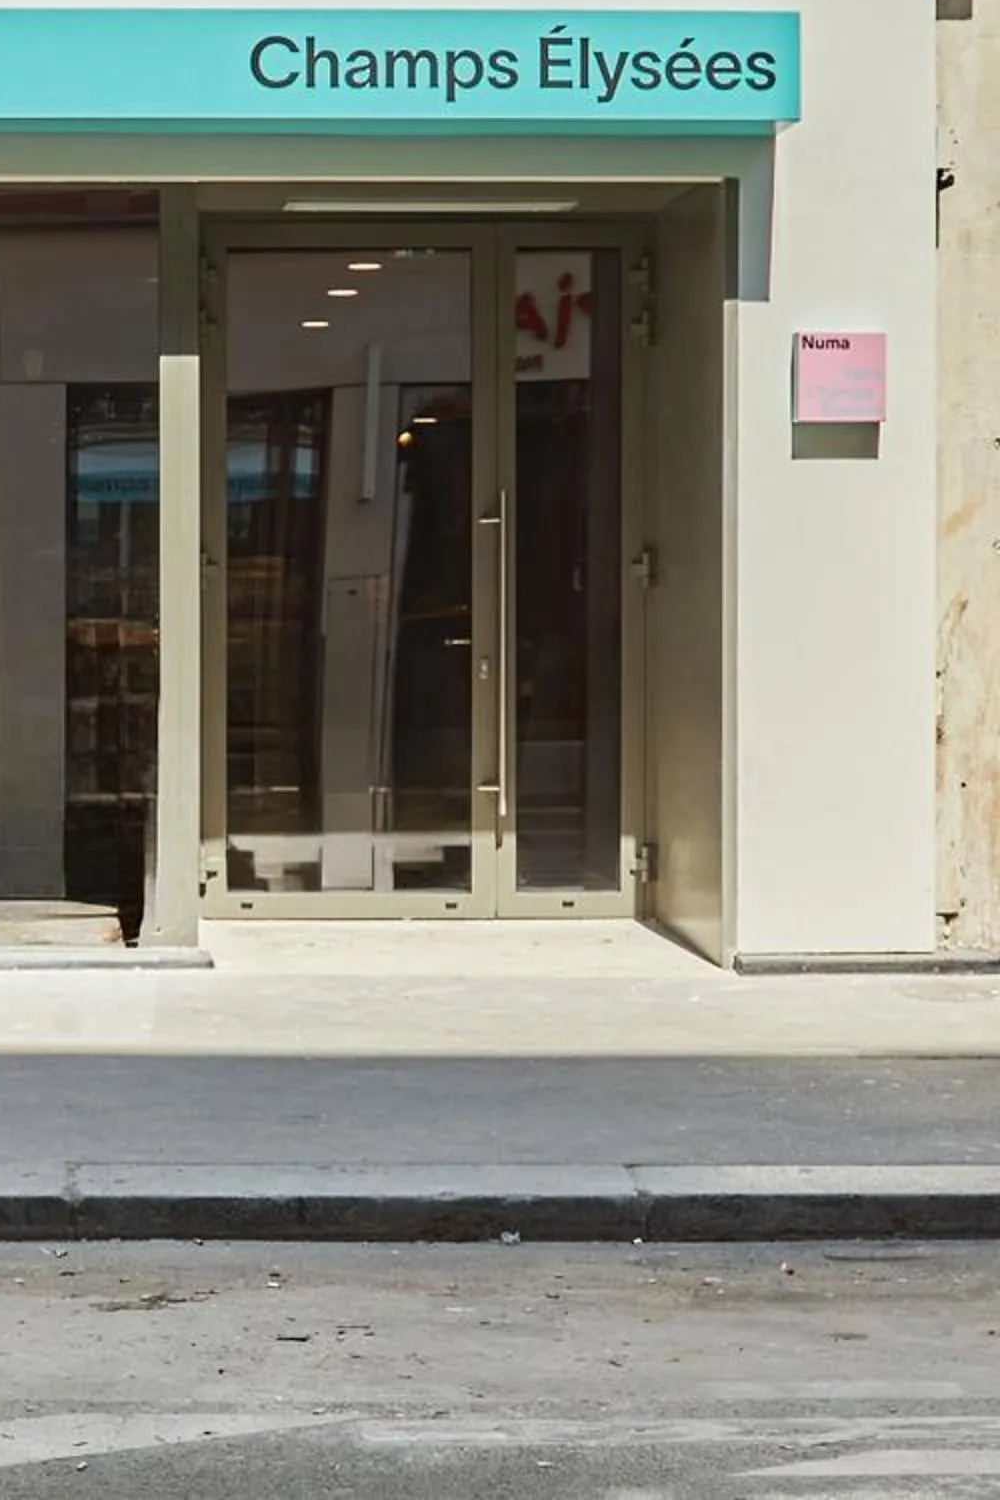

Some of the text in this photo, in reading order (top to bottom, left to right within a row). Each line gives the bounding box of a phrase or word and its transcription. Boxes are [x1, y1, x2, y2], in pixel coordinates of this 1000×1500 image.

[249, 24, 777, 104] Champs Élysées
[801, 335, 851, 350] Numa
